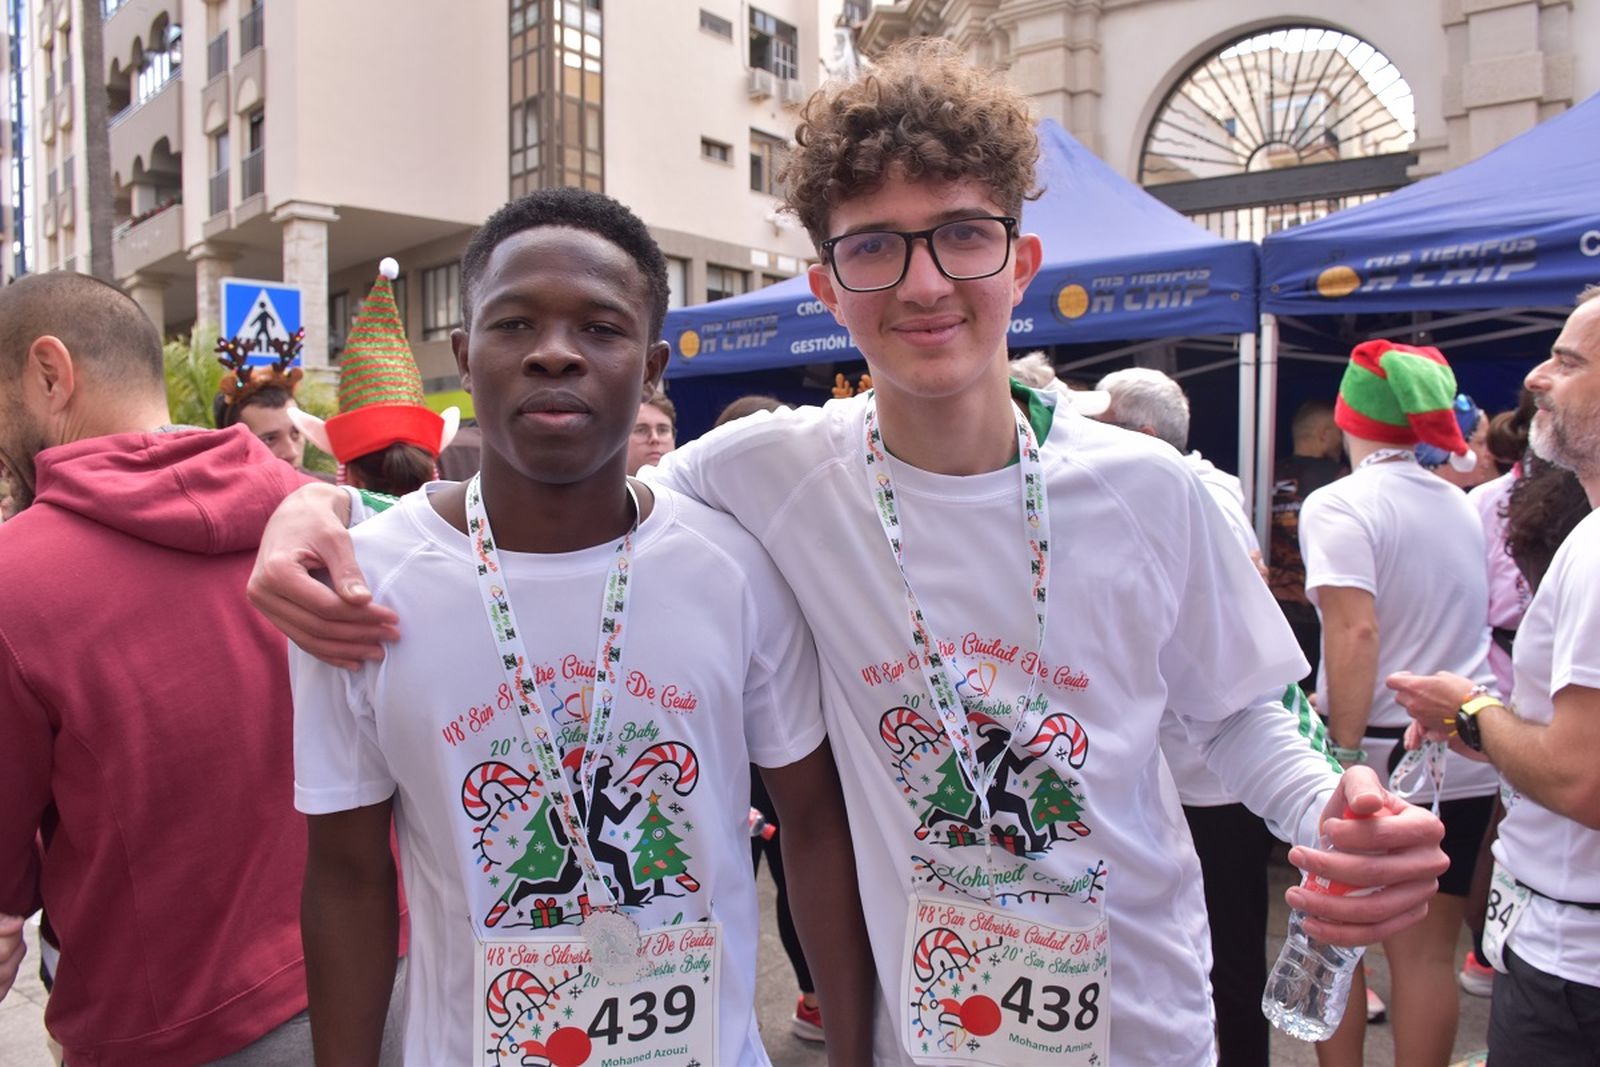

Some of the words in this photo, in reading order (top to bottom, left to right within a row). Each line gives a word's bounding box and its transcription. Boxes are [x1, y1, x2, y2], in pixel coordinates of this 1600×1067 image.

[790, 334, 847, 354] GESTIÓN
[962, 632, 1019, 663] Ciudad
[1053, 665, 1090, 689] Ceuta
[469, 706, 494, 733] San
[626, 670, 656, 697] De
[661, 684, 697, 711] Ceuta
[619, 720, 660, 742] Baby
[939, 906, 966, 926] San
[969, 912, 1020, 939] Silvestre
[1023, 925, 1071, 951] Ciudad
[509, 944, 541, 967] San
[543, 944, 593, 967] Silvest
[651, 933, 676, 957] De
[679, 929, 715, 953] Ceuta
[680, 952, 712, 975] Baby
[1023, 950, 1045, 969] San
[587, 984, 697, 1046] 439
[1000, 976, 1100, 1033] 438
[600, 1050, 653, 1067] Mohaned
[653, 1043, 689, 1059] Azouzi
[1008, 1032, 1063, 1054] Mohamed
[1064, 1041, 1094, 1054] Amine
